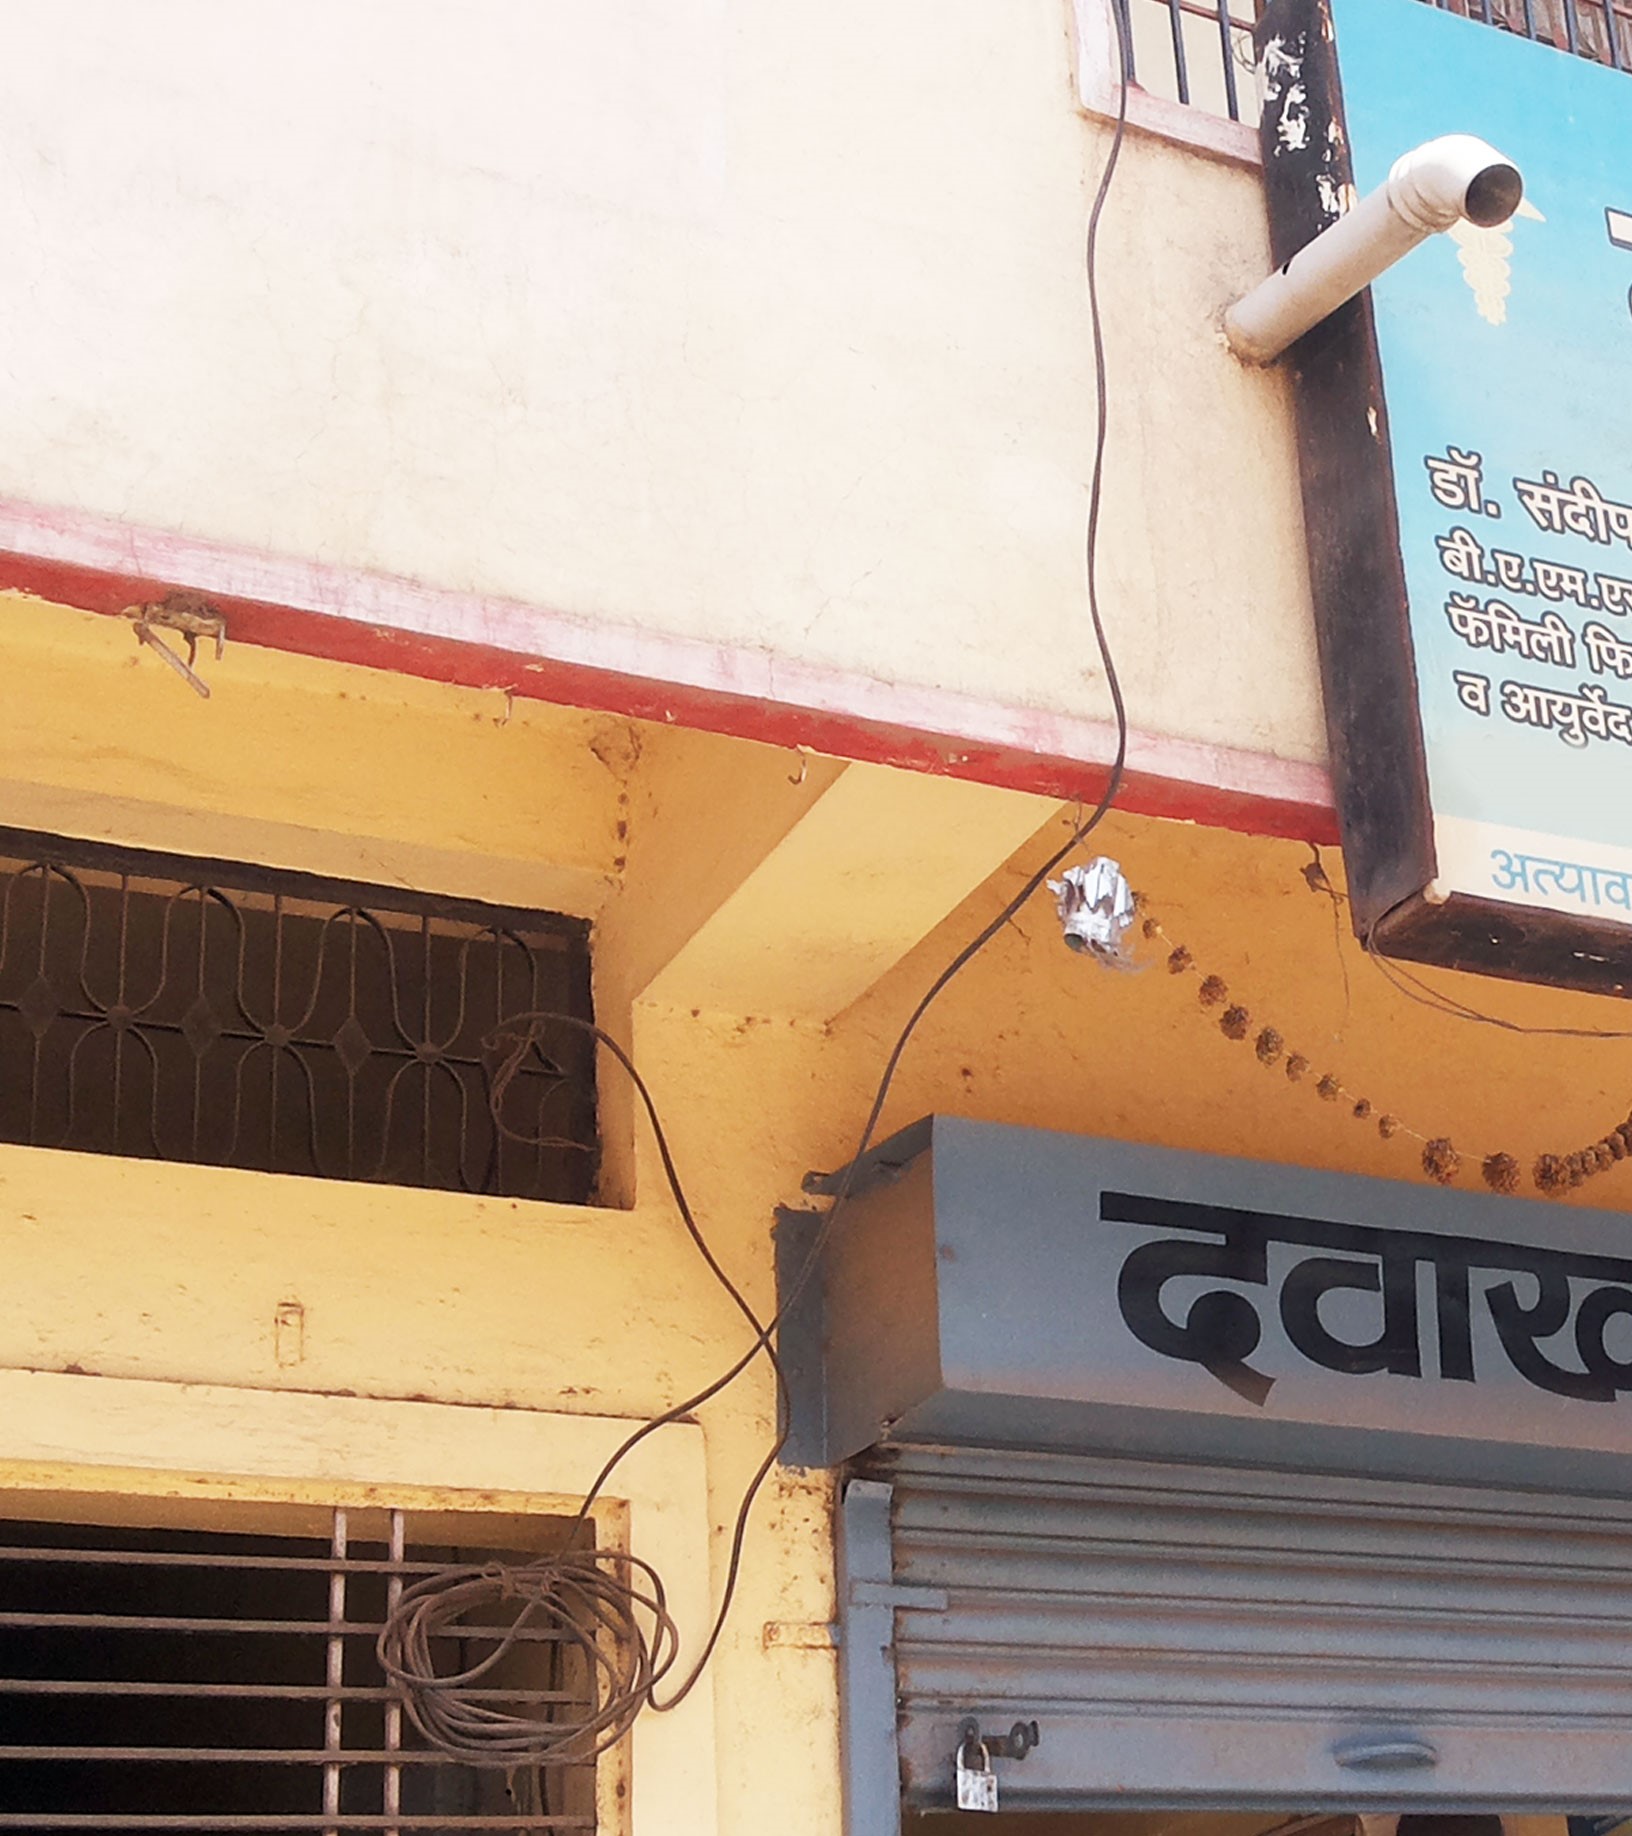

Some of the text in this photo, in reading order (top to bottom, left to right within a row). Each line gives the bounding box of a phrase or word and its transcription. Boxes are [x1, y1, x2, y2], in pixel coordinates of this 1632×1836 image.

[1425, 447, 1500, 518] डॉ.
[1446, 593, 1575, 669] फॅमिली
[1455, 669, 1490, 716] व
